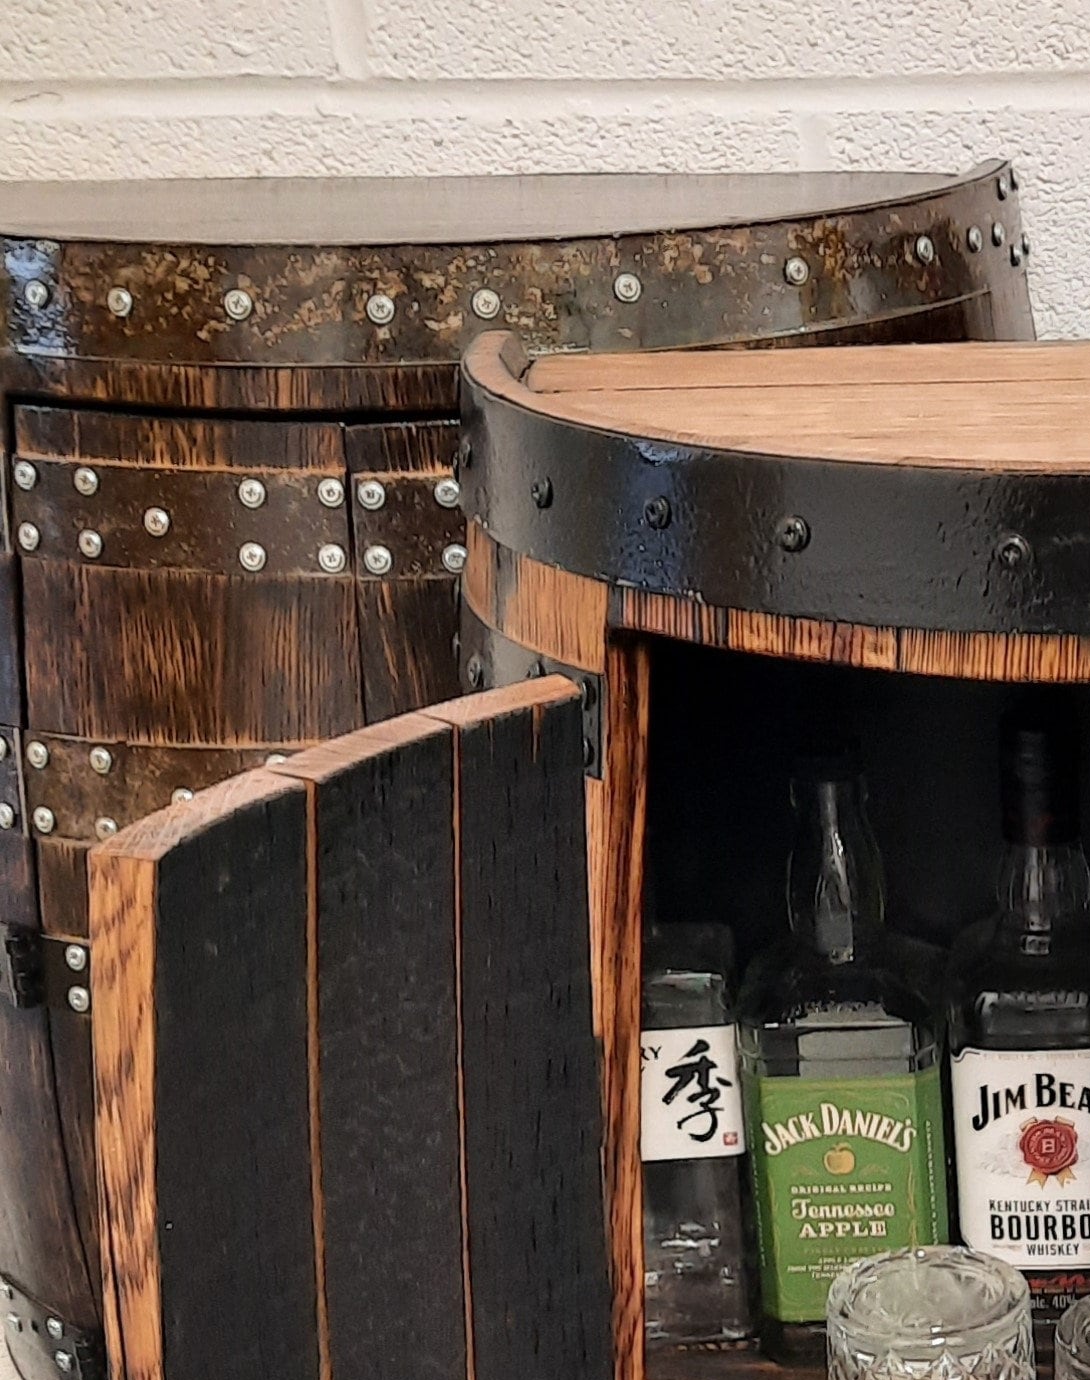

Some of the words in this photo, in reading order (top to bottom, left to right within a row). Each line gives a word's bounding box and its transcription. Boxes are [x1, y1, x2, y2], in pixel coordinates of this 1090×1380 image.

[662, 1039, 732, 1142] 季
[972, 1084, 1028, 1131] JIM
[761, 1111, 822, 1156] JACK
[820, 1102, 917, 1152] DANIEL'S
[791, 1199, 895, 1219] Tennessee
[988, 1199, 1050, 1213] KENTUCKY
[799, 1220, 887, 1239] APPLE
[1026, 1243, 1080, 1256] WHISKEY
